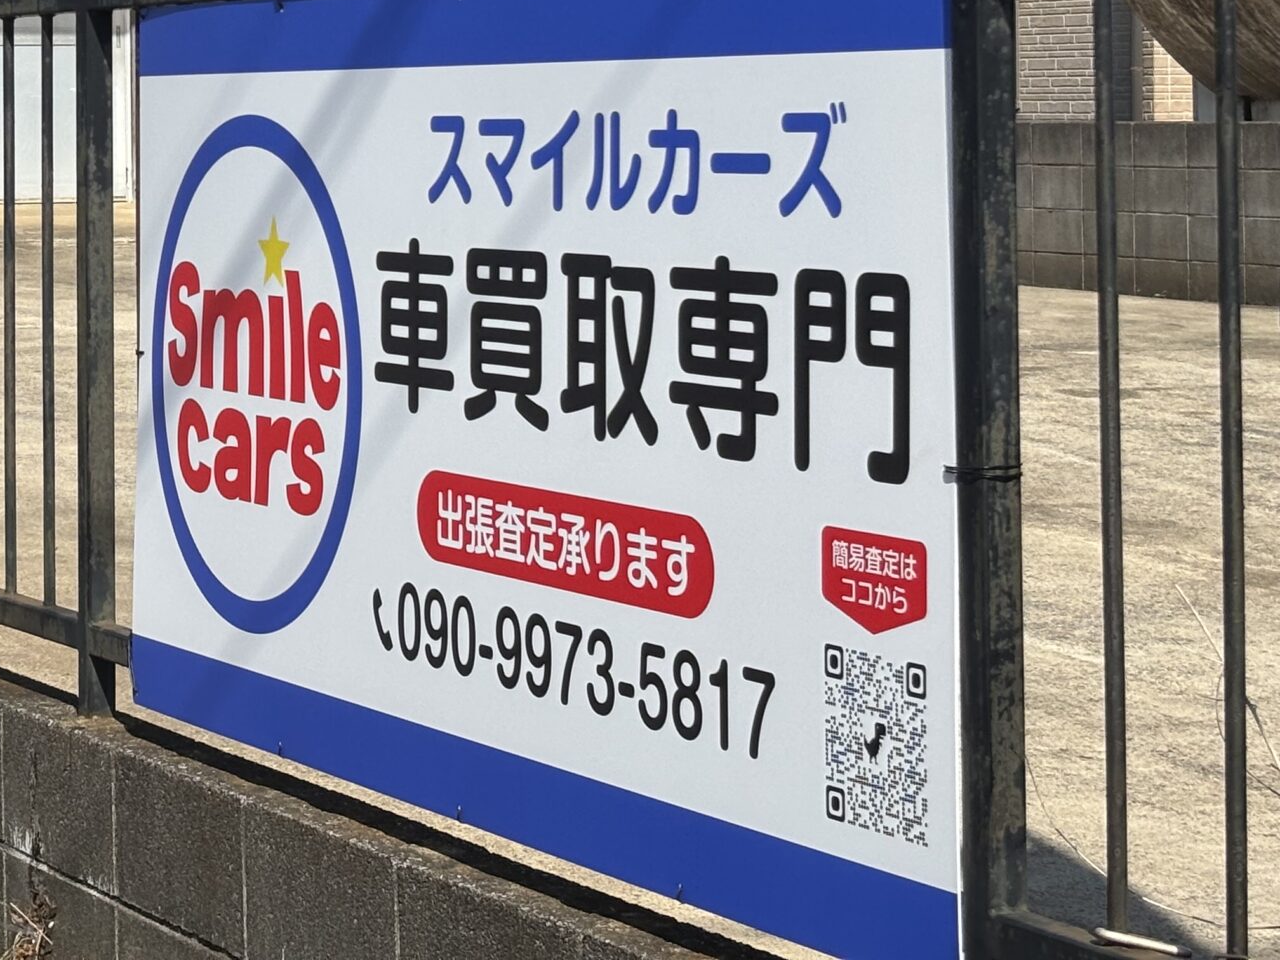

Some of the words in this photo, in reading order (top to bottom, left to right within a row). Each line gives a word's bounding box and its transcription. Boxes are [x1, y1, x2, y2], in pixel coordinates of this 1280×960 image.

[427, 101, 847, 219] スマイルカーズ
[167, 260, 342, 412] Smile
[374, 237, 911, 485] 車買取専門
[176, 398, 326, 517] cars
[435, 488, 696, 598] 出張査定承ります
[832, 539, 917, 580] 簡易査定は
[841, 578, 908, 614] ココから
[396, 582, 776, 759] 090-9973-5817
